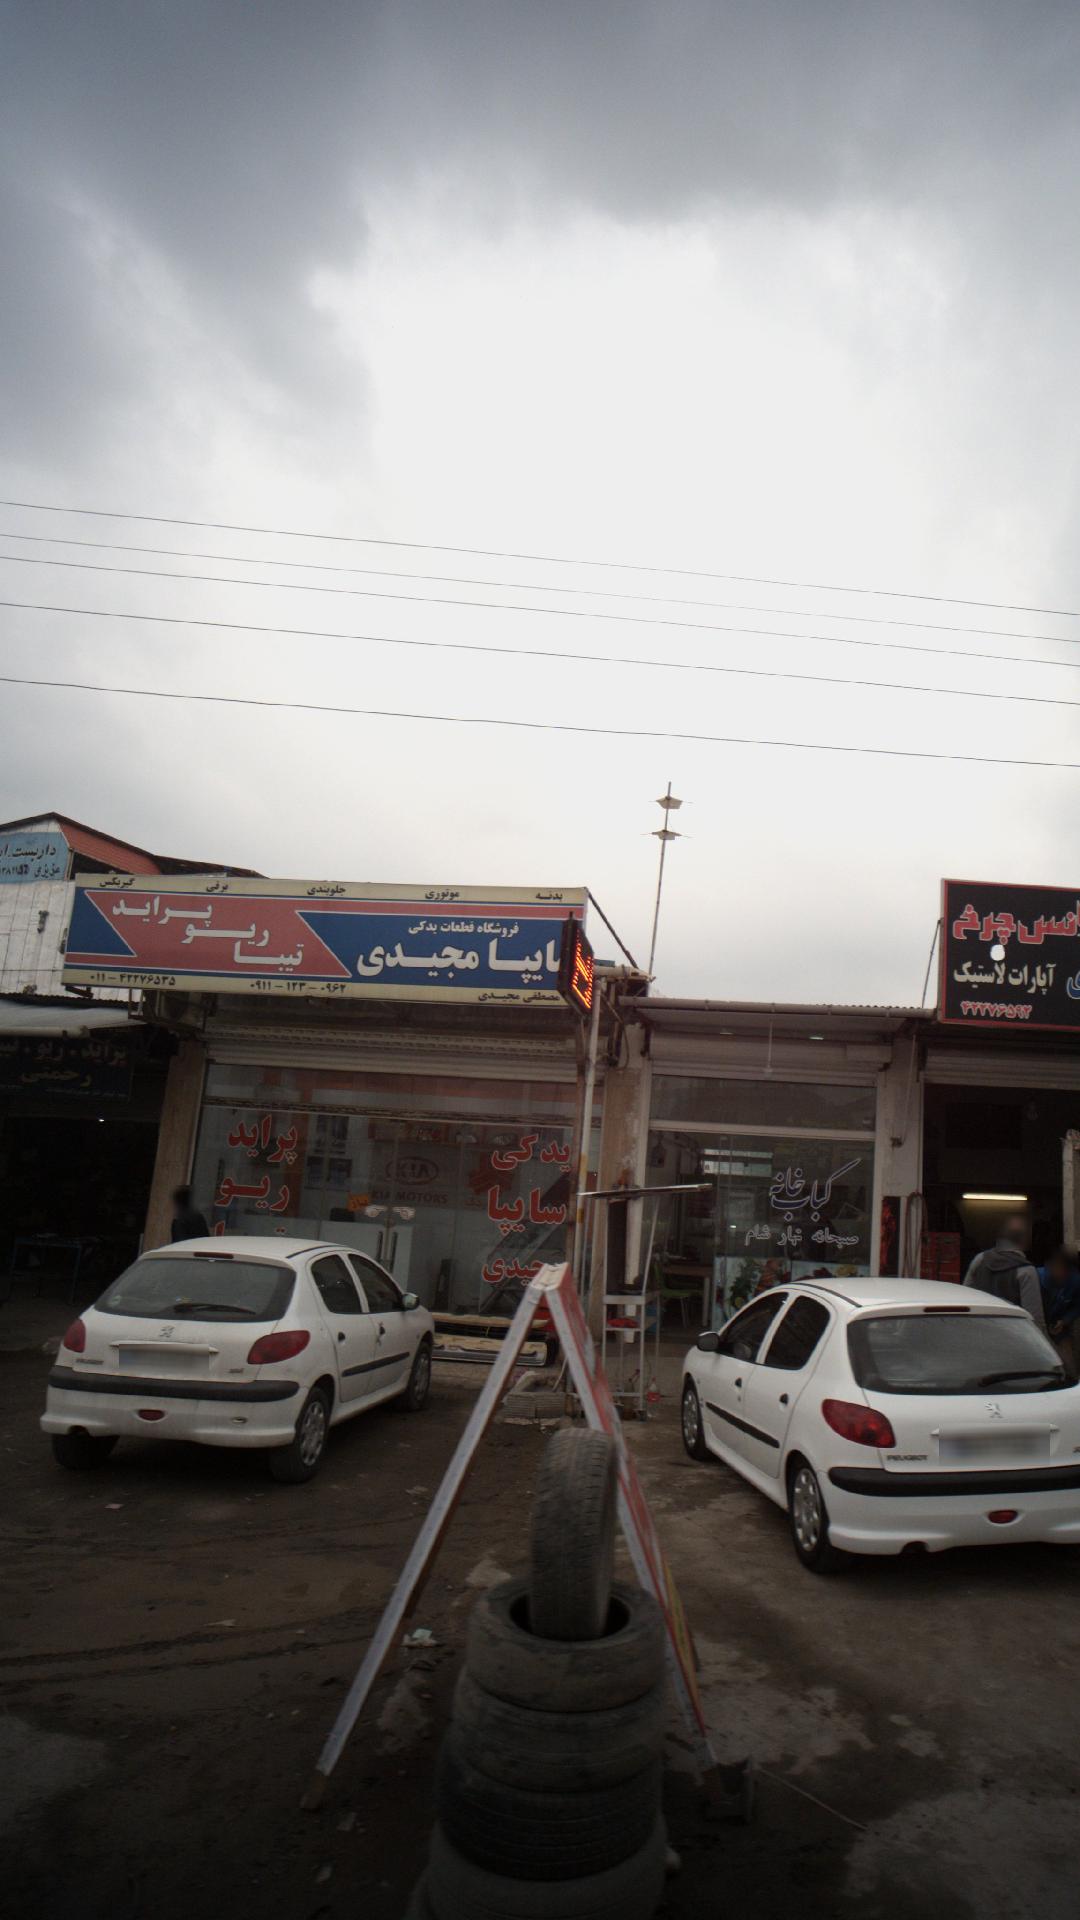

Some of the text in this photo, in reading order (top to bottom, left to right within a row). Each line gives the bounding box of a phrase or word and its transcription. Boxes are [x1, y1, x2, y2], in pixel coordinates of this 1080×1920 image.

[206, 881, 229, 893] برقی
[307, 885, 346, 897] جلوبندی
[425, 890, 460, 902] موتوری
[112, 896, 213, 927] پراید
[952, 904, 1017, 945] چرخ
[181, 923, 270, 947] ریو
[408, 920, 519, 938] فروشگاه قطعات یدکی
[233, 941, 304, 972] تیبا
[357, 942, 480, 978] مجیدی
[488, 938, 561, 984] ایپا
[953, 961, 1006, 989] لاستیک
[1008, 963, 1057, 995] آپارات
[478, 991, 520, 1002] مجیدی
[228, 1113, 298, 1165] پراید
[491, 1133, 571, 1172] یدکی
[215, 1175, 290, 1211] ریو
[395, 1191, 448, 1204] MOTORS
[769, 1158, 862, 1222] کباب خانه
[487, 1184, 567, 1236] سایپا
[744, 1223, 859, 1248] صبحانه نهار شام
[482, 1258, 545, 1286] جیدی
